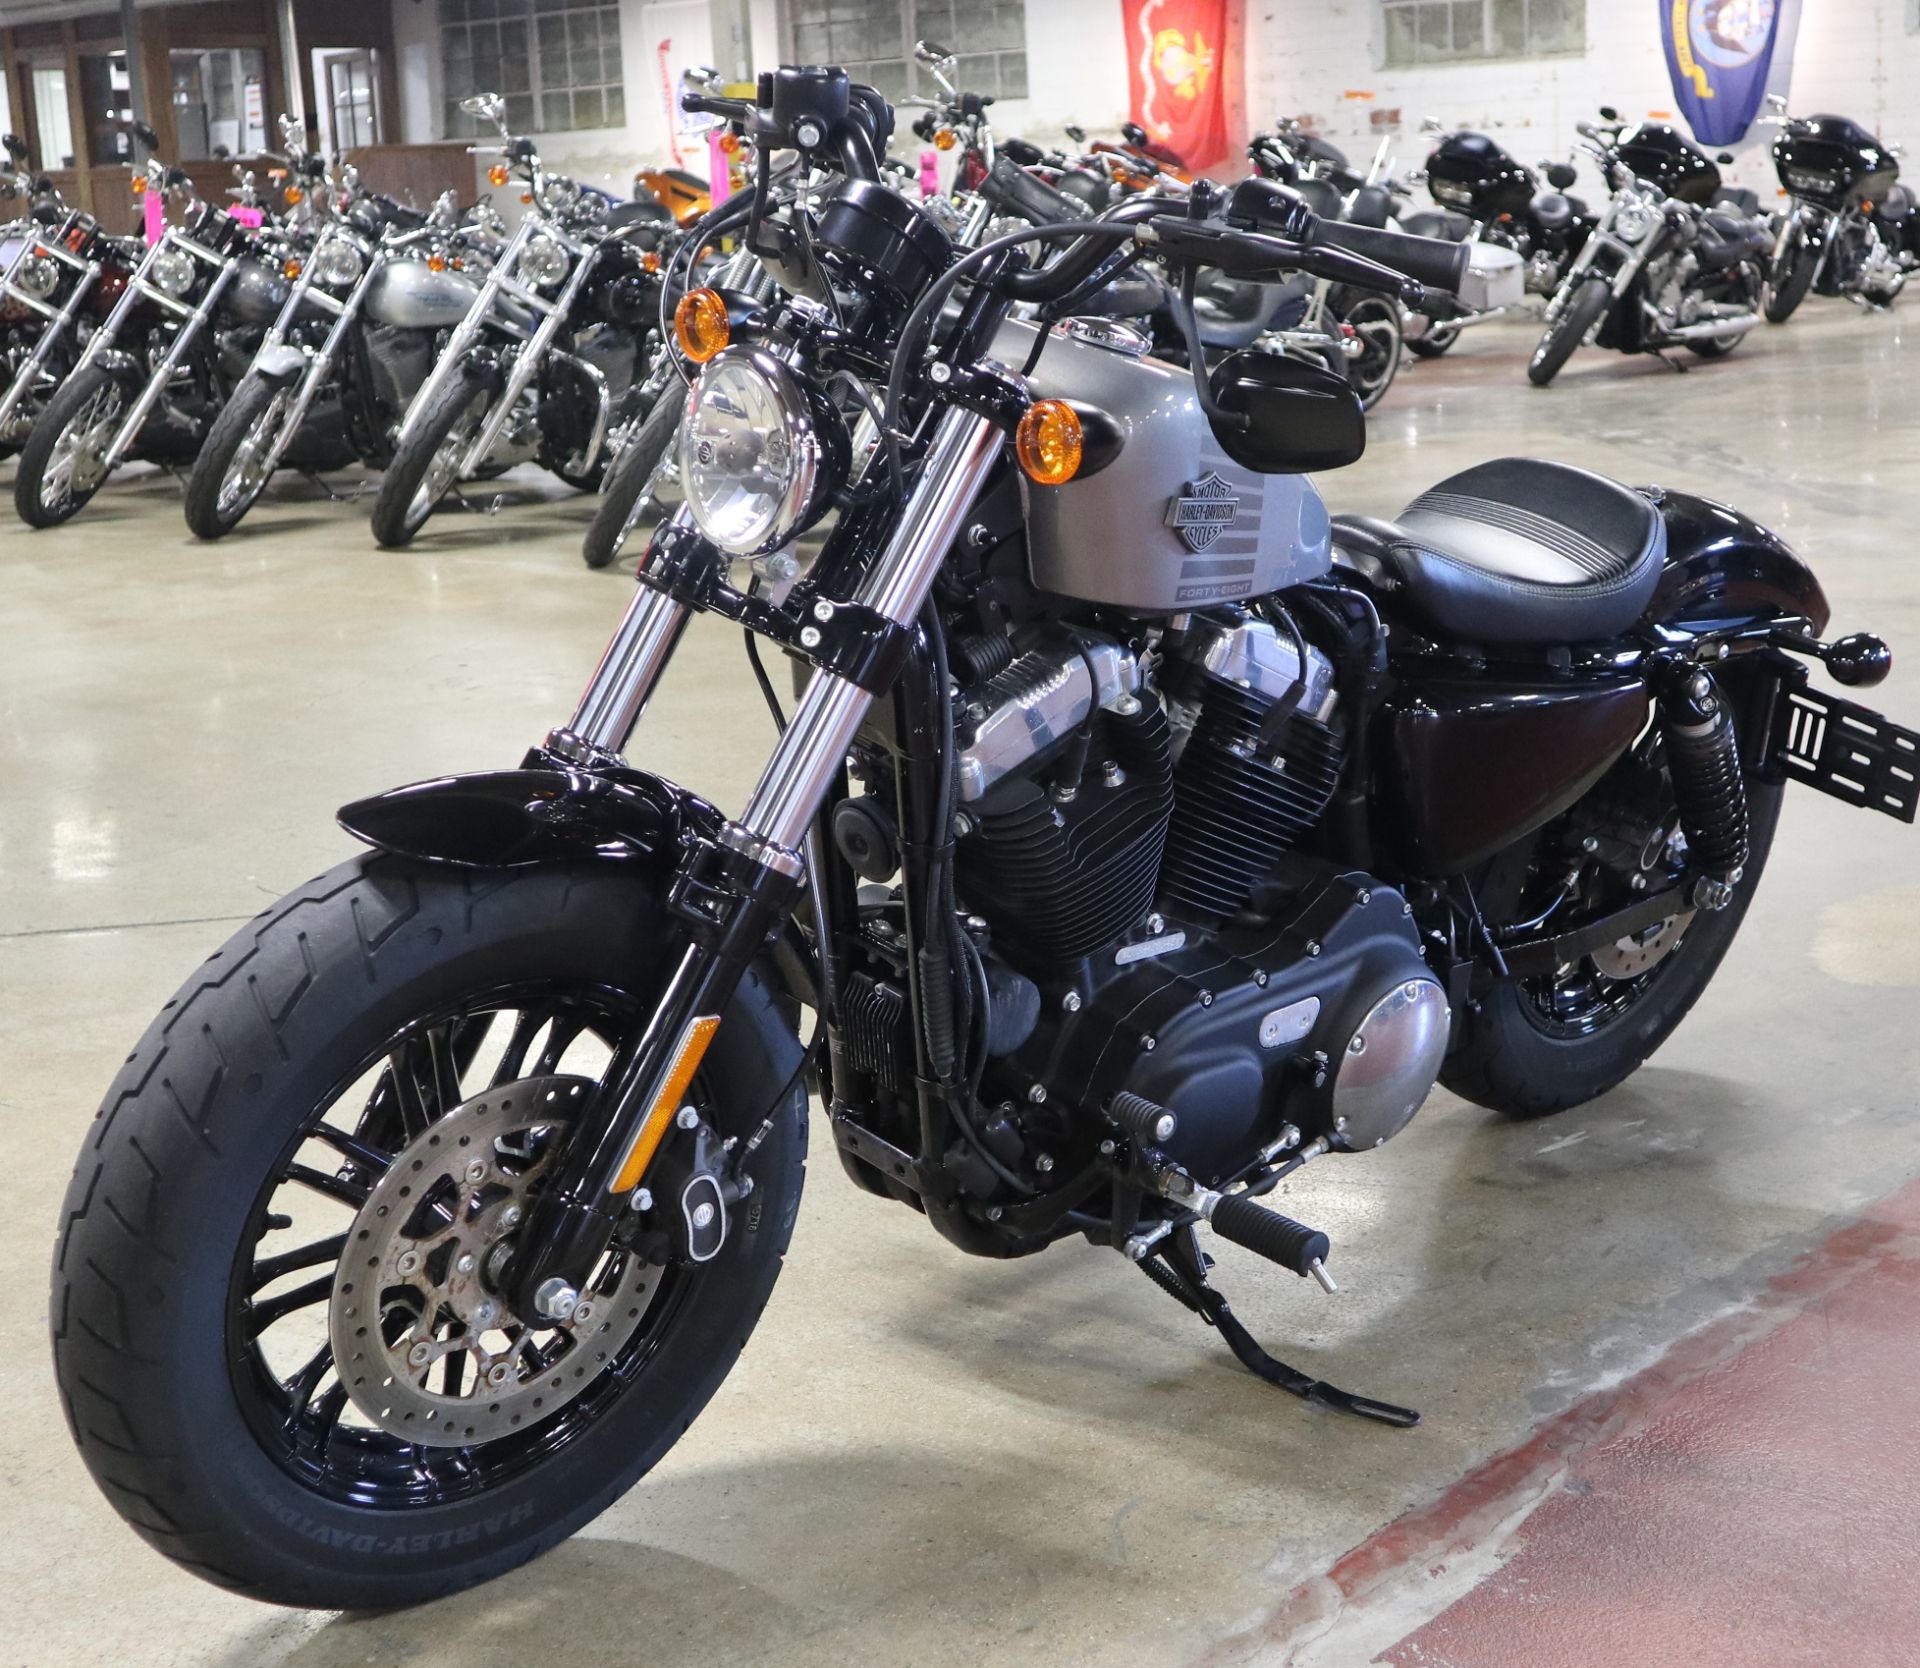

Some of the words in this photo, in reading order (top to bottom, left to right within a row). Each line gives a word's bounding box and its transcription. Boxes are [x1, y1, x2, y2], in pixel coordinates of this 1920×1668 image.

[1197, 480, 1226, 498] MOTOR
[1180, 504, 1235, 520] HARLEY-DAVIDSON
[1189, 526, 1218, 546] CYCLES
[1179, 584, 1249, 598] FORTY-EIGHT
